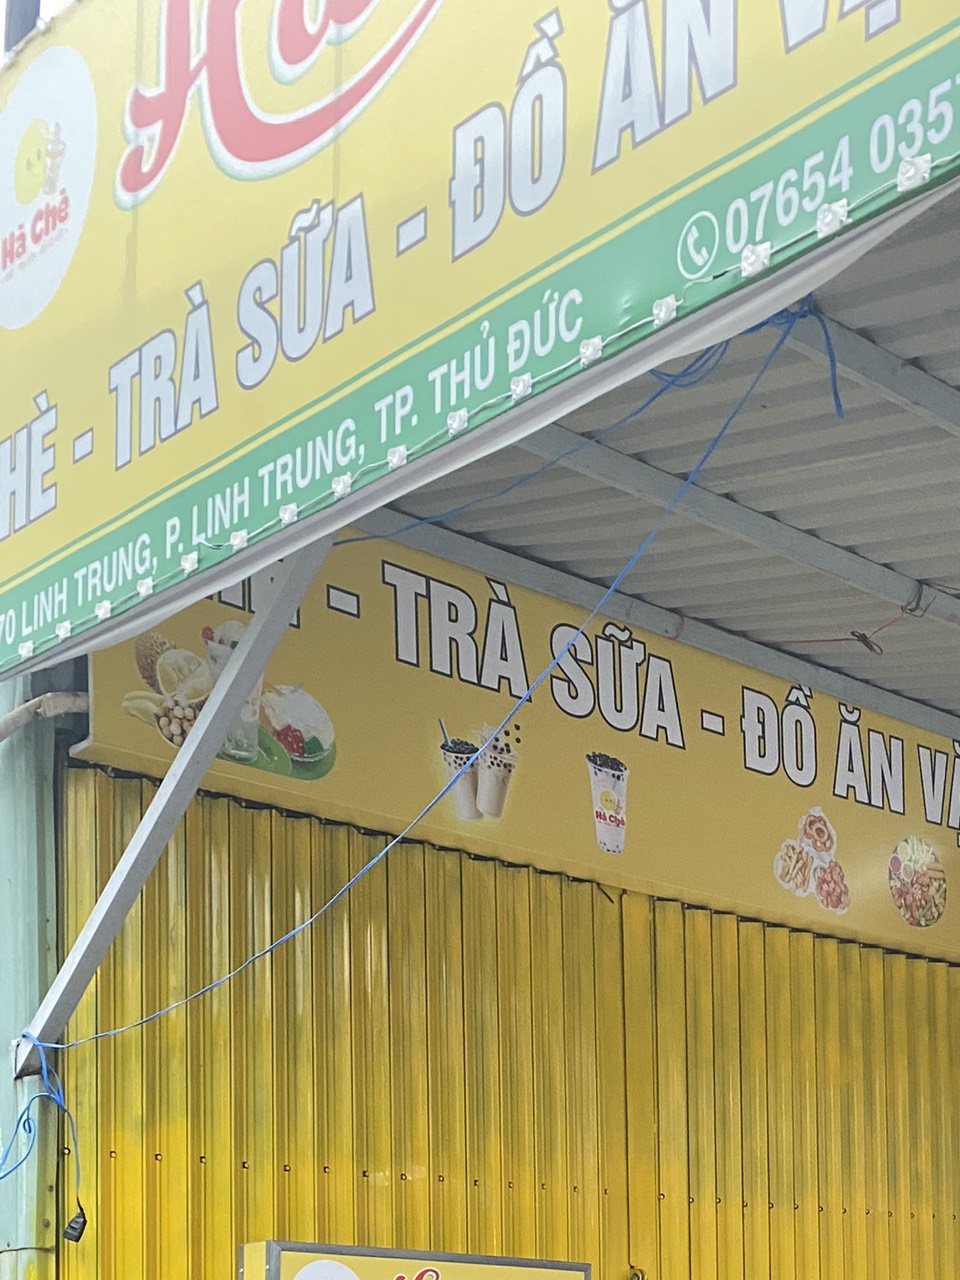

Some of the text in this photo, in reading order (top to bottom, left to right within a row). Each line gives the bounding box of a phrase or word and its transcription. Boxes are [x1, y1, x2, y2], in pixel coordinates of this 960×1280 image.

[108, 281, 219, 471] TRÀ
[235, 191, 376, 390] SỮA
[448, 6, 567, 263] ĐỒ
[725, 138, 854, 254] 07654
[22, 578, 68, 637] LINH
[74, 532, 158, 607] TRUNG,
[165, 516, 184, 559] P.
[192, 482, 250, 544] LINH
[257, 418, 366, 507] TRUNG,
[375, 384, 419, 443] TP.
[428, 320, 497, 416] THỦ
[507, 287, 584, 373] ĐỨC
[380, 558, 533, 703] TRÀ
[549, 621, 686, 751] SỮA
[740, 683, 817, 788] ĐỒ
[832, 702, 905, 816] ĂN
